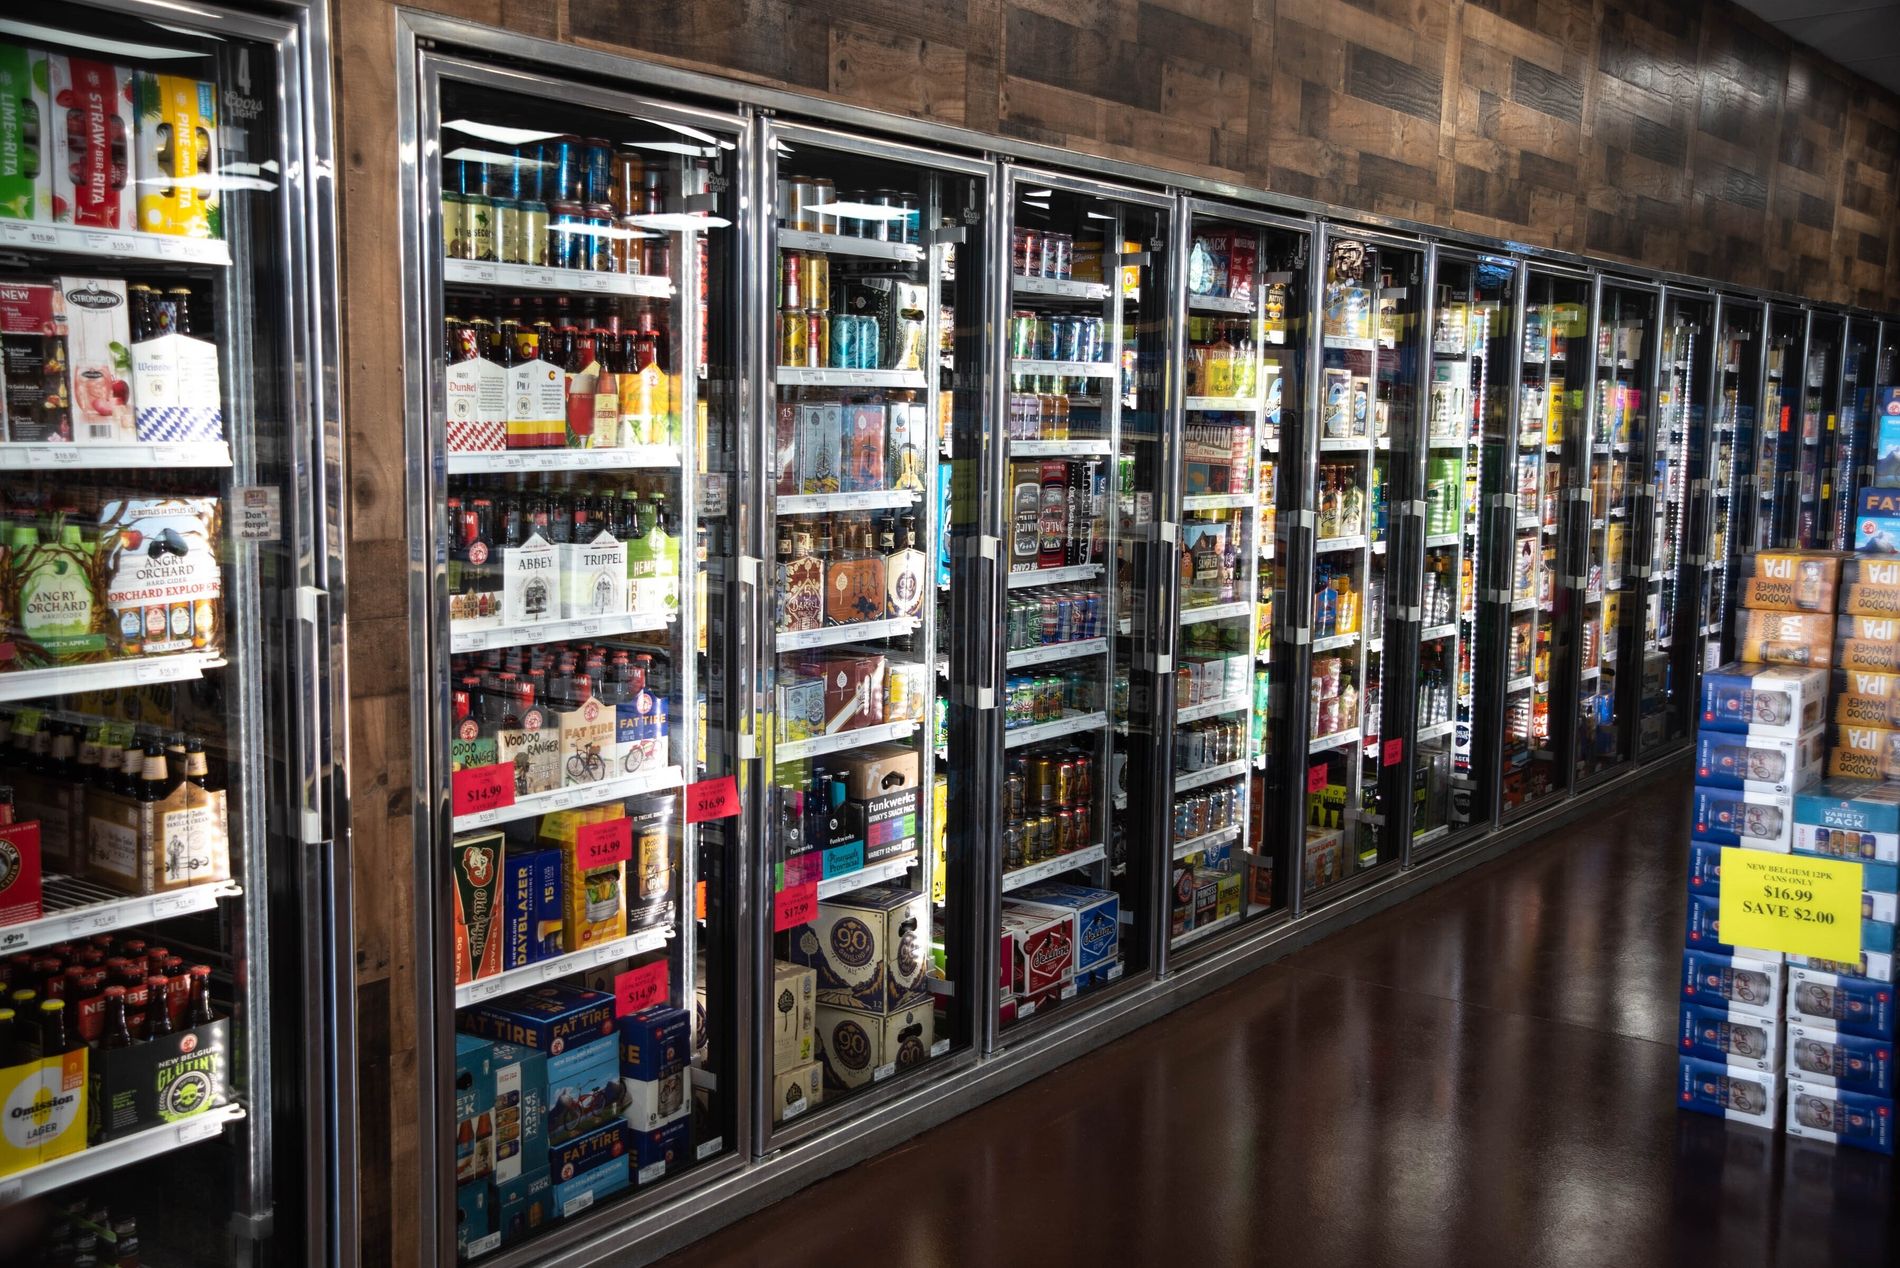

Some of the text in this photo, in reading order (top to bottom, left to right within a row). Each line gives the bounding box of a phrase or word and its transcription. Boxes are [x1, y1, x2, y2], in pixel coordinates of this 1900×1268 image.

[1, 291, 29, 301] NEW
[449, 381, 477, 392] Dunkel
[245, 511, 267, 519] Don't
[244, 520, 269, 530] forget
[241, 530, 255, 538] the
[145, 555, 184, 569] ANGRY
[518, 555, 553, 570] ABBEY
[584, 554, 624, 566] TRIPPEL
[136, 564, 194, 580] ORCHARD
[1764, 559, 1791, 578] IPA
[1868, 564, 1898, 584] IPA
[110, 588, 163, 602] ORCHARD
[1756, 582, 1792, 593] RANGER
[1859, 588, 1900, 600] RANGER
[34, 591, 76, 602] ANGRY
[1755, 593, 1793, 604] VOODOO
[27, 601, 87, 613] ORCHARD
[1858, 599, 1899, 612] VOODOO
[1781, 616, 1802, 641] IPA
[1863, 620, 1892, 640] IPA
[1853, 644, 1892, 655] RANGER
[1853, 654, 1892, 668] VOODOO
[1856, 674, 1887, 695] IPA
[1848, 698, 1886, 710] RANGER
[619, 713, 667, 729] FAT TIRE
[1847, 709, 1887, 723] VOODOO
[565, 727, 587, 739] FAT
[590, 721, 614, 735] TIRE
[505, 732, 540, 747] VOODOO
[1848, 729, 1878, 750] IPA
[453, 743, 477, 756] ODOO
[527, 740, 559, 755] RANGER
[464, 749, 498, 766] RANGER
[1840, 752, 1880, 766] RANGER
[1839, 763, 1879, 777] VOODOO
[467, 785, 502, 802] $14.99
[697, 797, 726, 812] $16.99
[868, 793, 916, 813] funkwerks
[903, 803, 915, 815] PACK
[1824, 811, 1865, 821] VARIETY
[1825, 817, 1864, 828] PACK
[829, 834, 855, 845] funkwerks
[590, 840, 621, 857] $14.99
[868, 848, 886, 860] VARIETY
[1746, 862, 1834, 881] NEW BELGIUM 12PK
[1763, 873, 1814, 887] CANS ONLY
[544, 886, 554, 904] 15
[1763, 885, 1813, 903] $16.99
[517, 867, 528, 966] DAYBLAZER
[784, 904, 809, 920] $17.99
[1742, 900, 1835, 925] SAVE $2.00
[838, 928, 868, 948] 90
[1082, 924, 1114, 945] Session
[490, 927, 498, 974] 12-PACK
[1033, 941, 1070, 967] Session
[629, 985, 658, 1003] $14.99
[553, 1007, 611, 1038] FAT TIRE
[496, 1021, 538, 1047] TIRE
[159, 1059, 178, 1069] NEW
[157, 1053, 219, 1093] GLUTINY
[11, 1094, 74, 1118] Omission
[27, 1122, 57, 1139] LAGER
[563, 1128, 621, 1164] FAT TIRE
